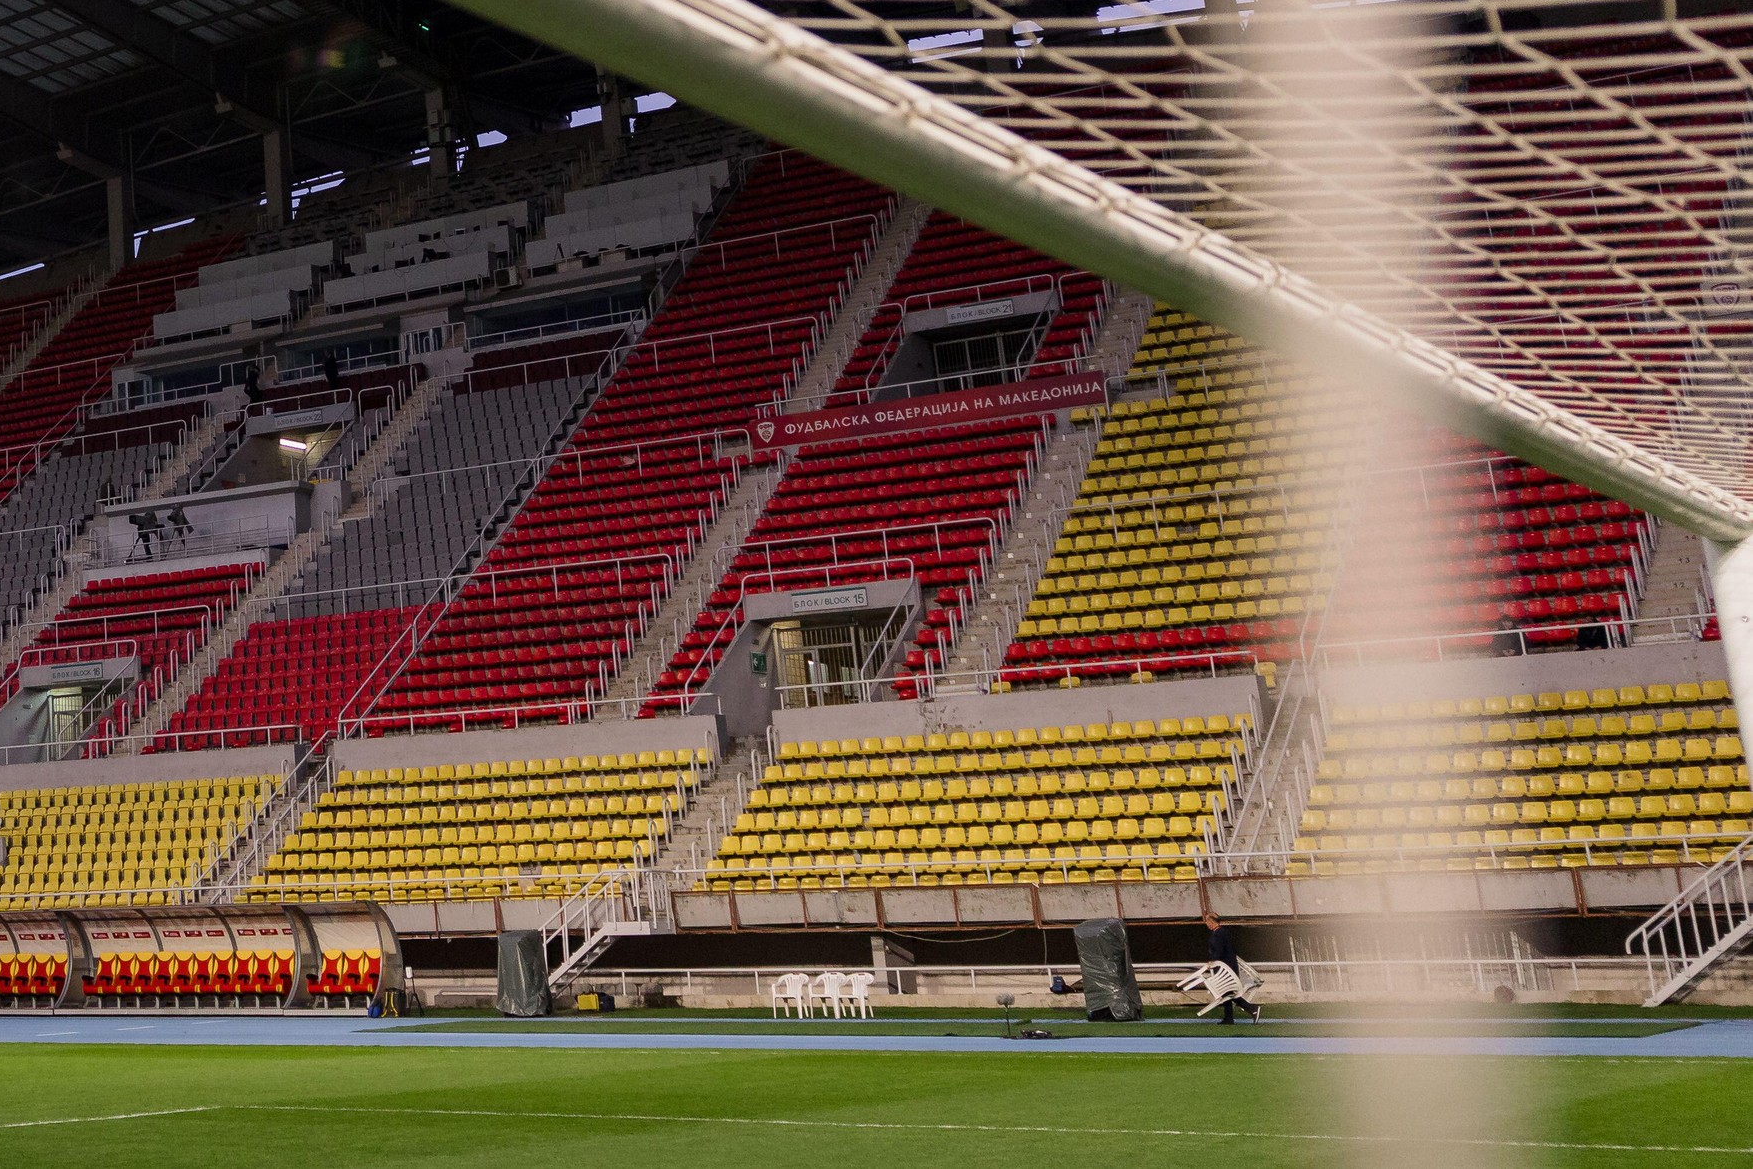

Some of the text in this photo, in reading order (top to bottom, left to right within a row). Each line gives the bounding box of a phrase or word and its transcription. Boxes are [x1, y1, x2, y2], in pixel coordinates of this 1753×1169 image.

[1002, 304, 1012, 314] 21
[784, 381, 1103, 436] ФУДБАЛСКА ФЕДЕРАЦИЈА НА МАКЕДОНИЈА
[853, 593, 865, 604] 15
[92, 667, 101, 676] 16
